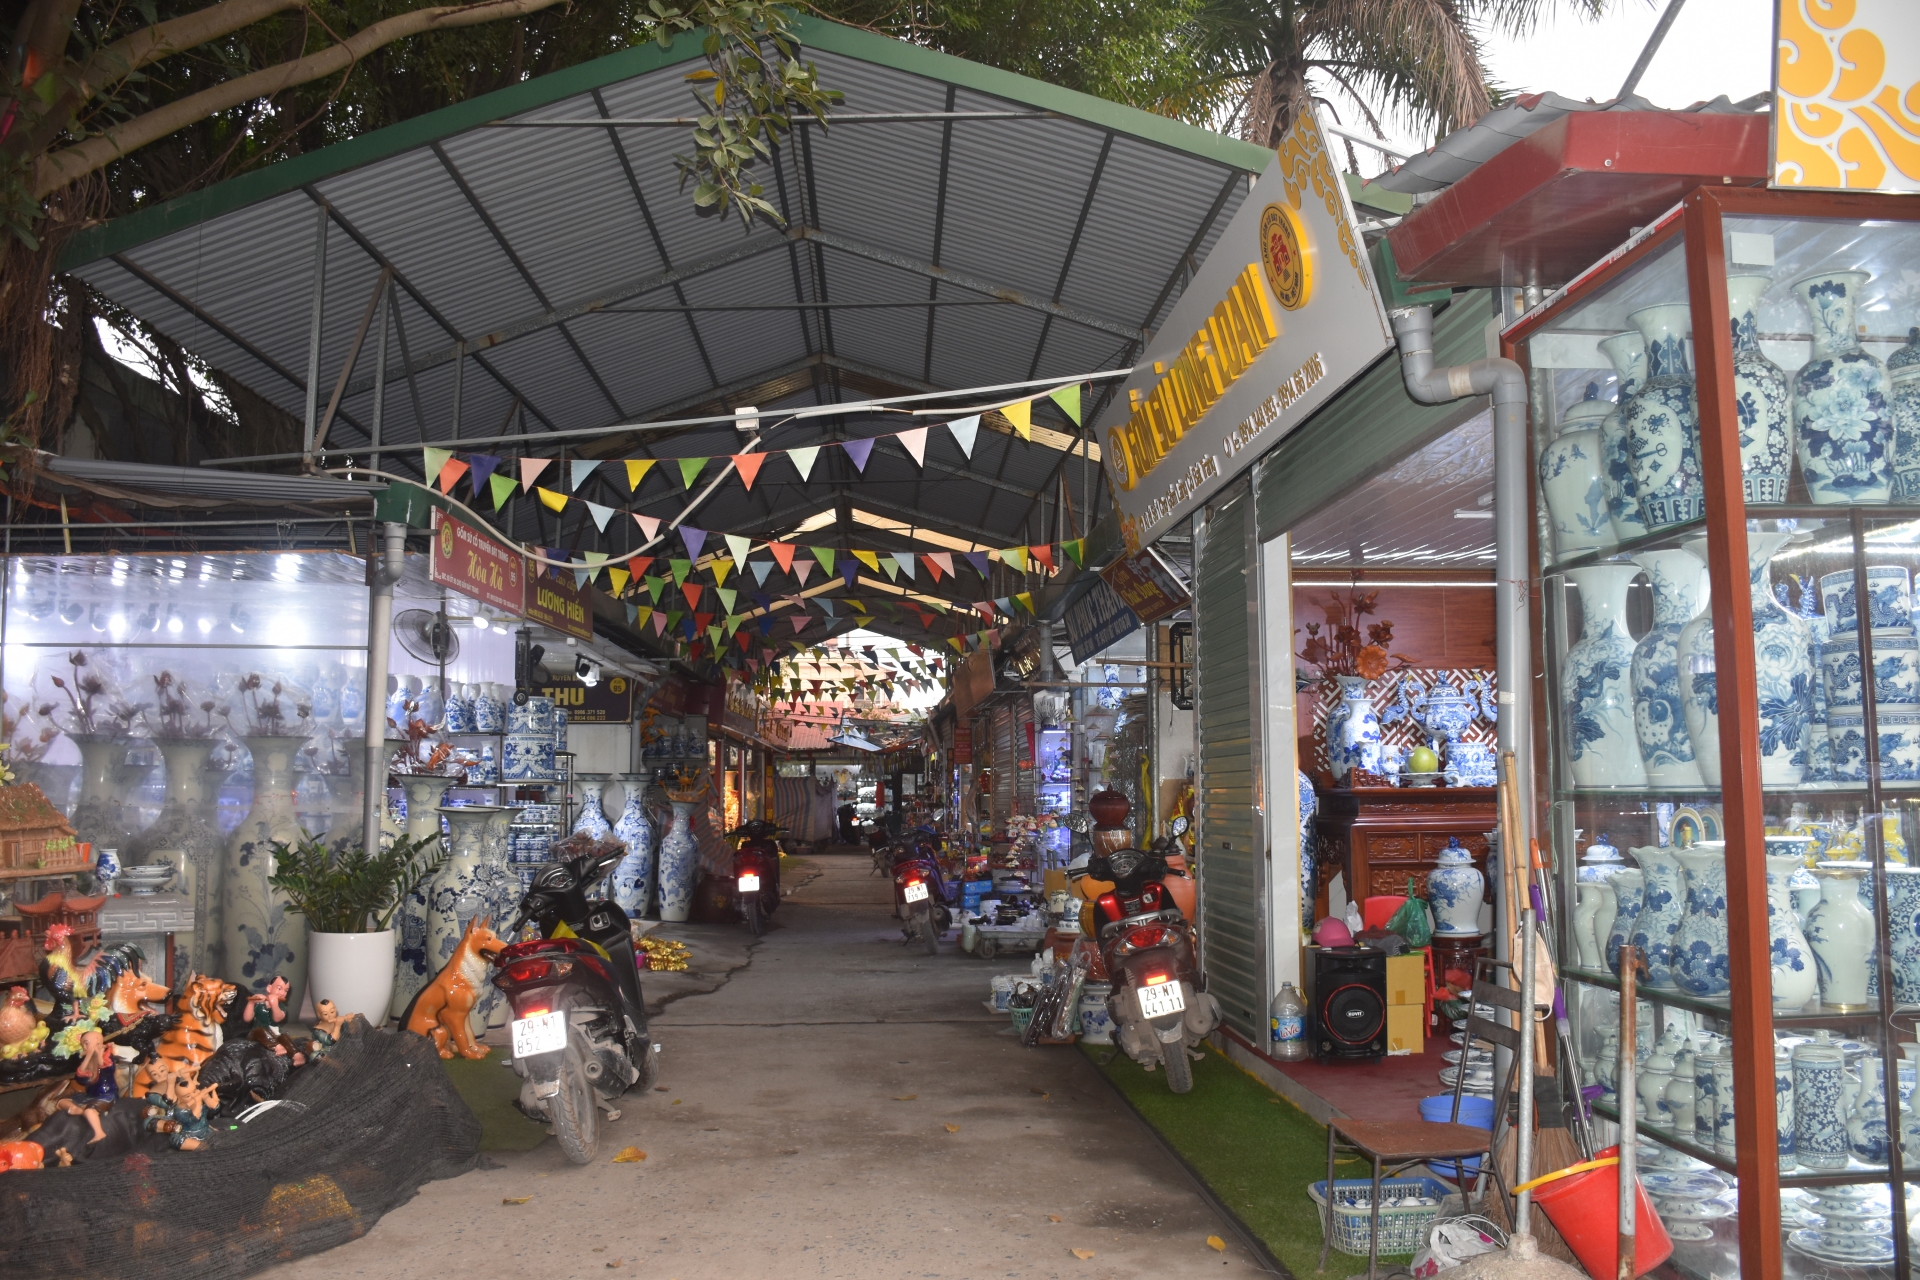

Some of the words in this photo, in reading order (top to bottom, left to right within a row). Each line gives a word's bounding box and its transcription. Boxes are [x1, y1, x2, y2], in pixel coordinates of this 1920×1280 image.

[456, 526, 467, 542] GỐM
[537, 586, 565, 616] LƯƠNG
[541, 687, 585, 706] THU
[1144, 984, 1175, 1001] 29-N1
[1145, 997, 1182, 1016] 441.11
